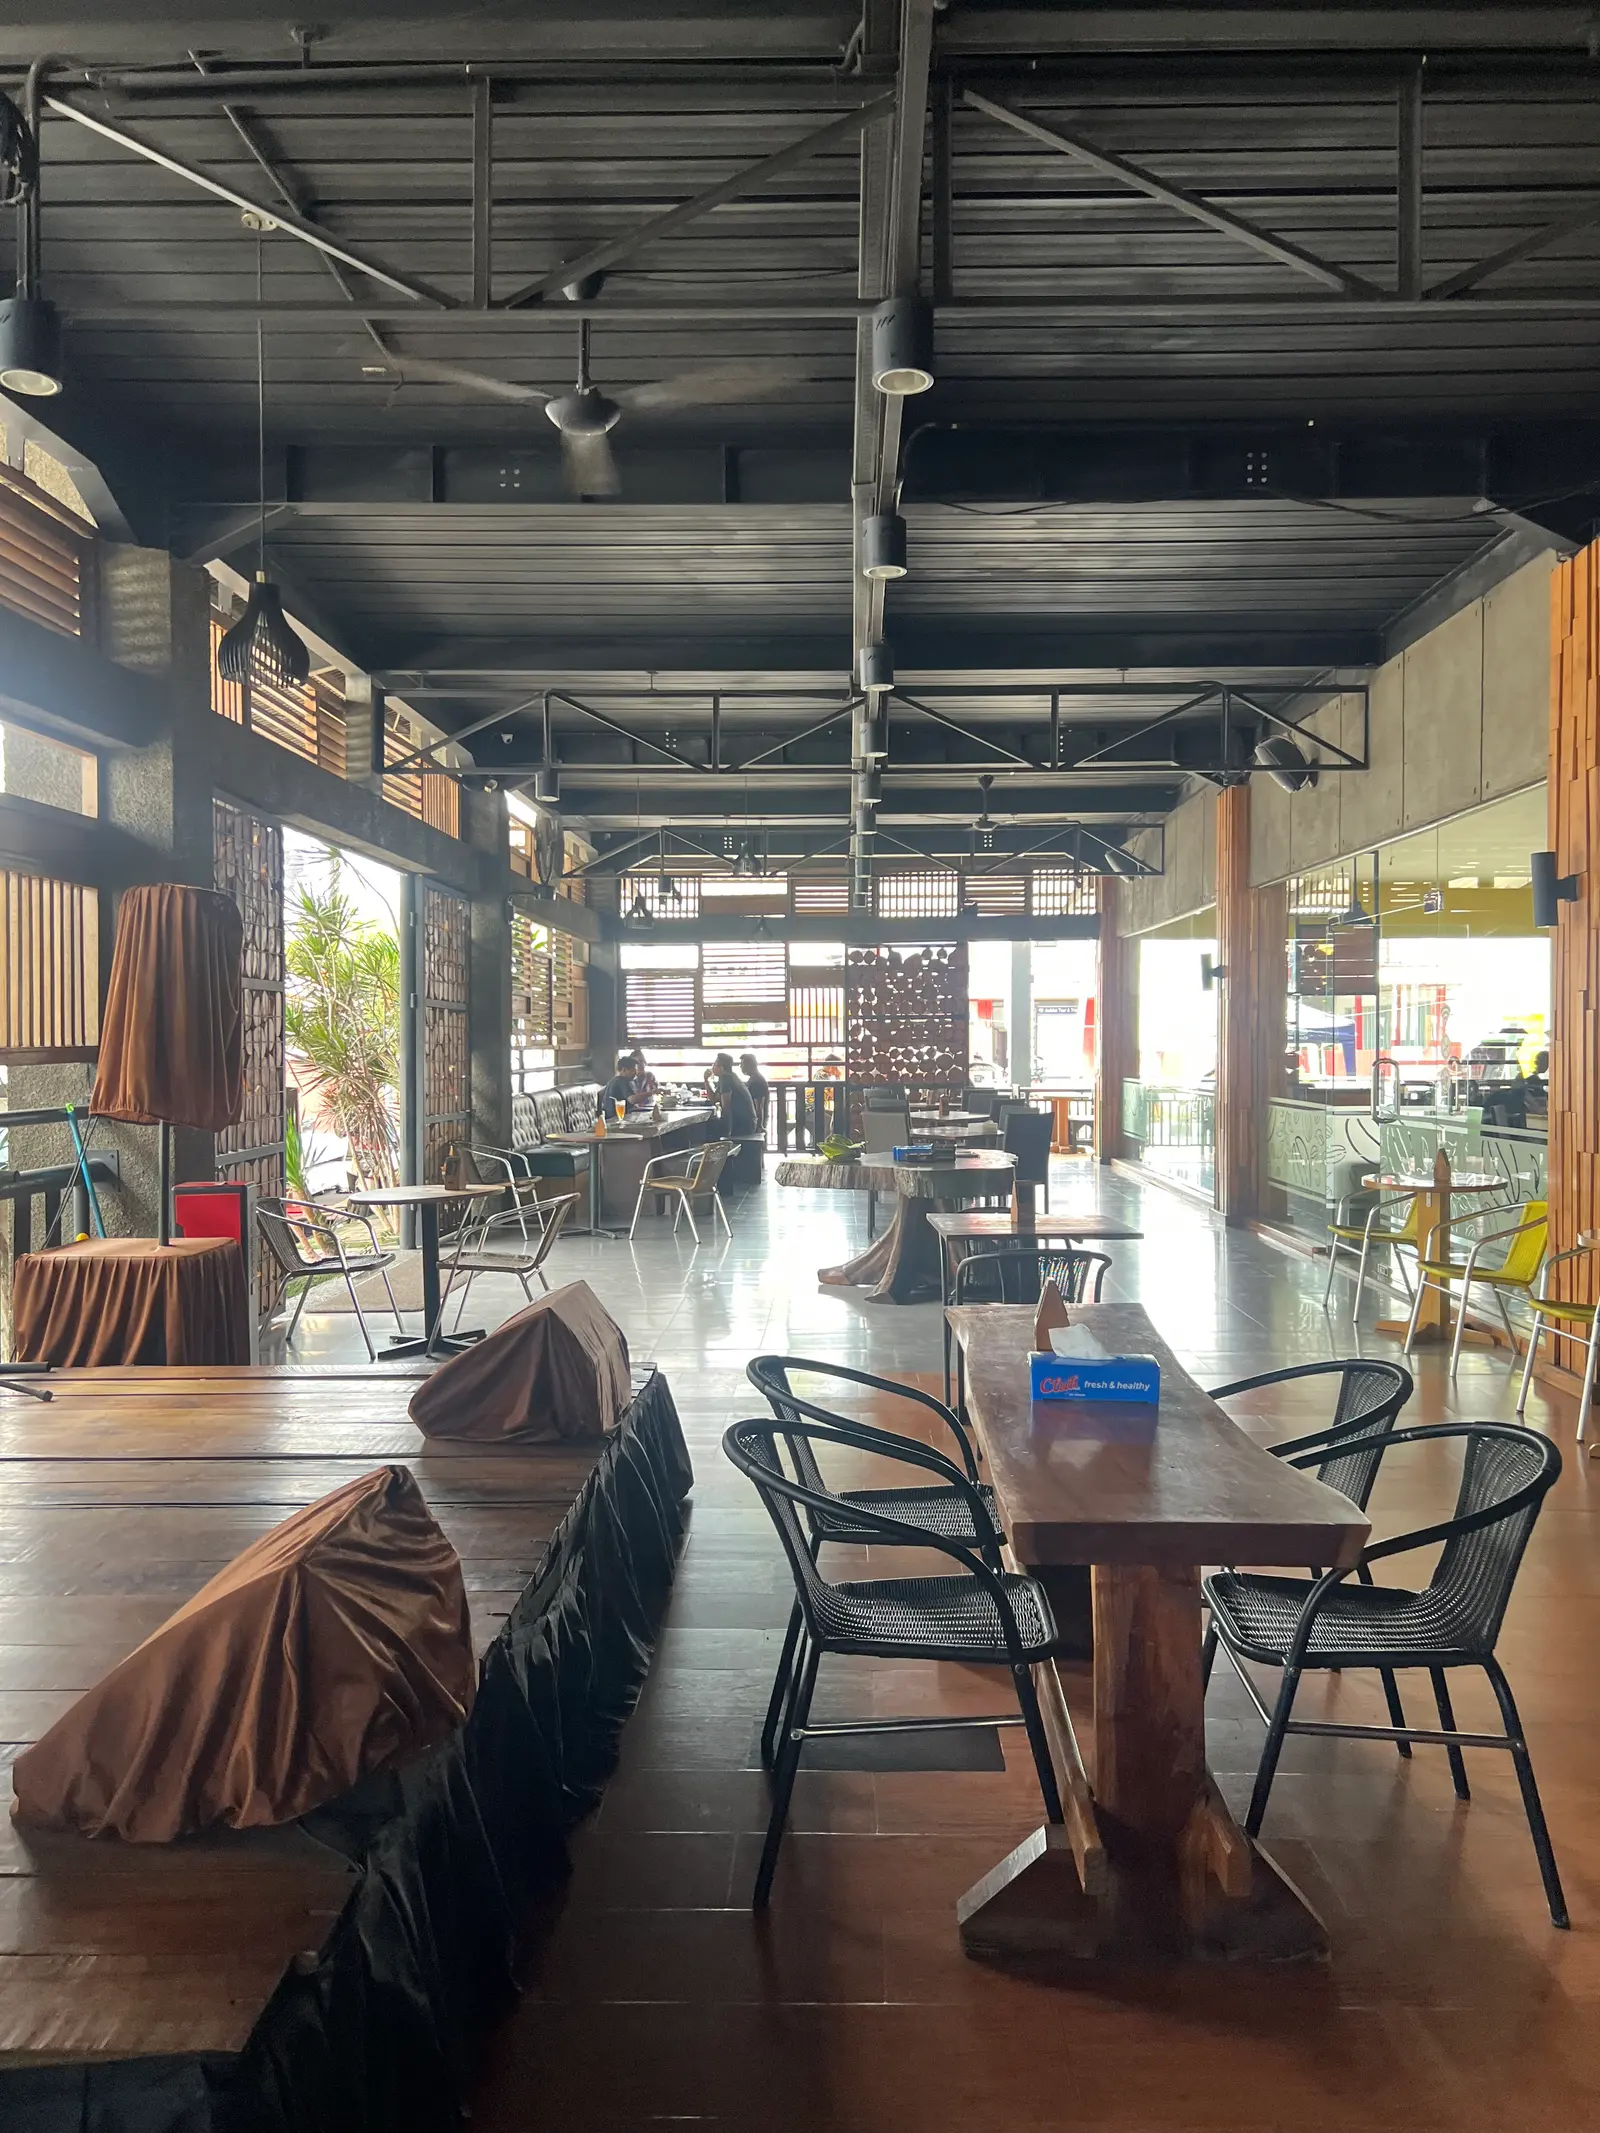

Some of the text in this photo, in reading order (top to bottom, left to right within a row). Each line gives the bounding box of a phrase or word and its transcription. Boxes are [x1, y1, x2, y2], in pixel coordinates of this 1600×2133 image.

[1084, 1380, 1151, 1392] fresh & healthy
